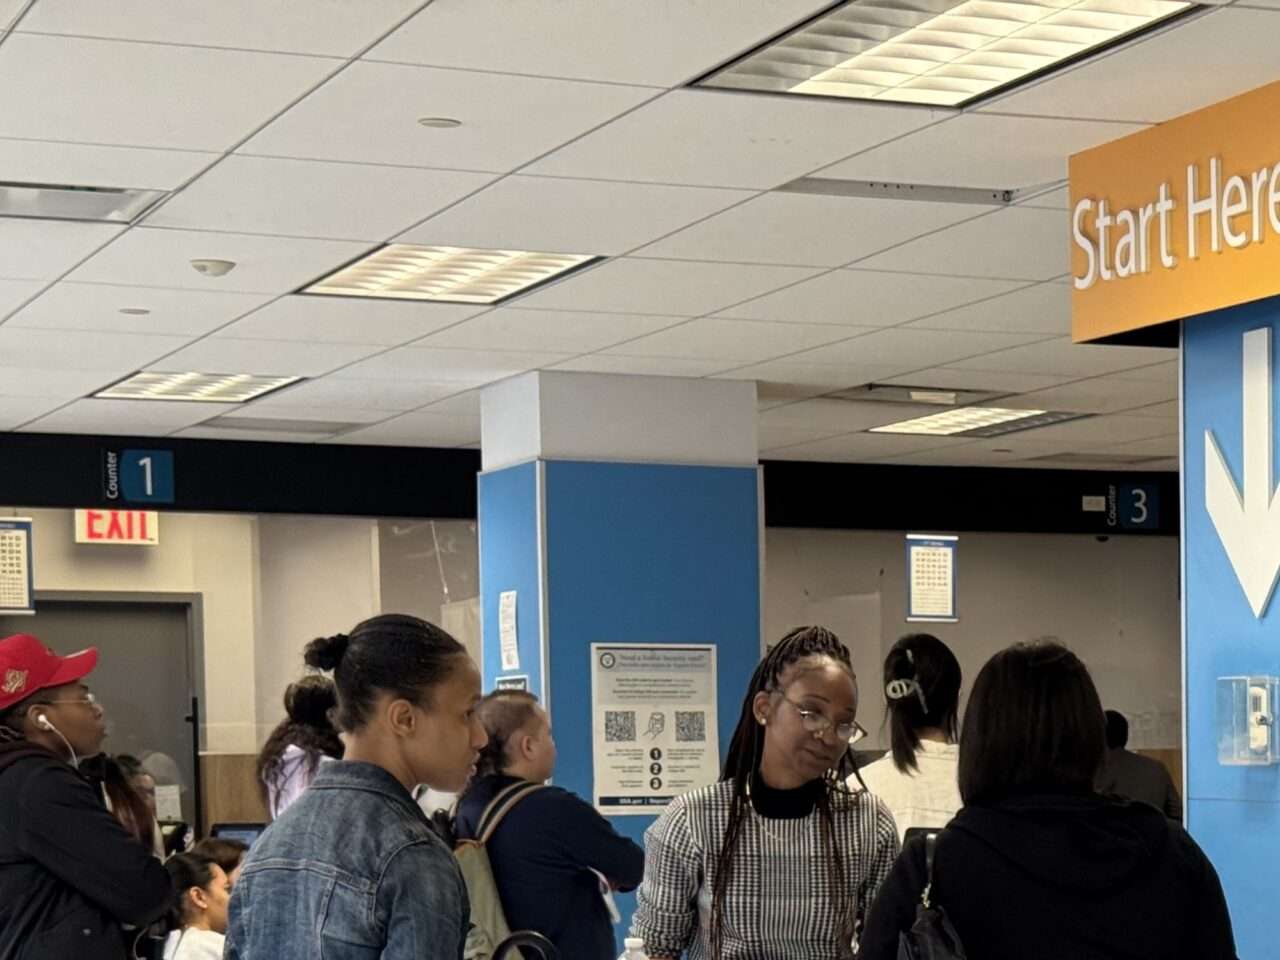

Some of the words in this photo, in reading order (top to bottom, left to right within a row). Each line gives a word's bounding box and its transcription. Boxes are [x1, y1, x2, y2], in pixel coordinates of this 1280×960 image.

[1073, 182, 1176, 290] Start
[106, 451, 119, 499] Counter
[138, 456, 153, 496] 1
[1106, 484, 1117, 527] Counter
[1130, 488, 1148, 524] 3
